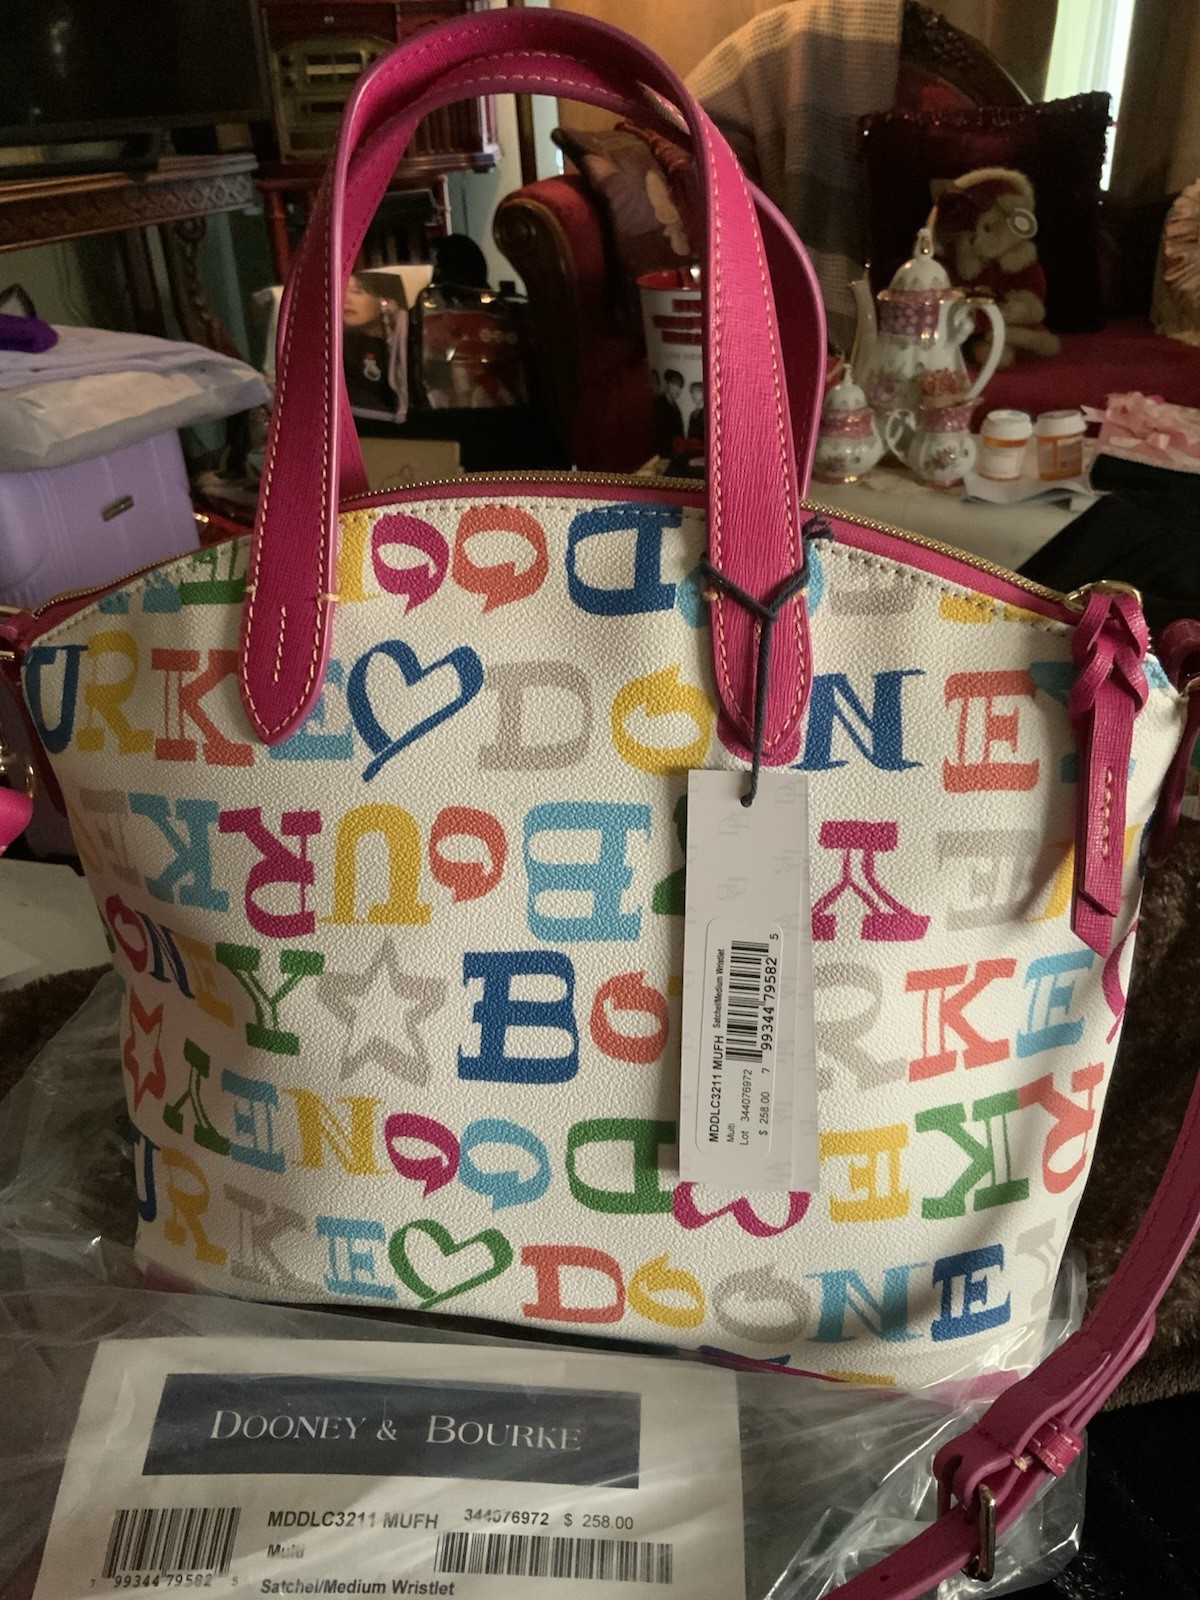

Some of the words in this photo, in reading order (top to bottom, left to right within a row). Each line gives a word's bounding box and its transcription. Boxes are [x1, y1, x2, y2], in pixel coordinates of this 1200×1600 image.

[714, 948, 726, 975] Wristlet
[763, 956, 778, 1002] 79582
[711, 975, 724, 1029] Satchel/Medium
[760, 1006, 775, 1051] 99344
[712, 1035, 725, 1071] MUFH
[761, 1067, 771, 1075] 7
[708, 1073, 723, 1143] MDDLC3211
[740, 1068, 753, 1123] 344076972
[726, 1122, 736, 1143] Multi
[739, 1130, 750, 1146] Lot
[758, 1129, 769, 1137] $
[209, 1409, 367, 1440] DOONEY
[376, 1419, 398, 1442] &
[425, 1414, 583, 1451] BOURKE
[267, 1510, 376, 1528] MDDLC3211
[382, 1512, 439, 1530] MUFH
[563, 1512, 574, 1528] $
[582, 1513, 635, 1531] 258.00
[113, 1574, 161, 1589] 99344
[260, 1578, 387, 1595] Satchel/Medium
[391, 1579, 456, 1596] Wristlet
